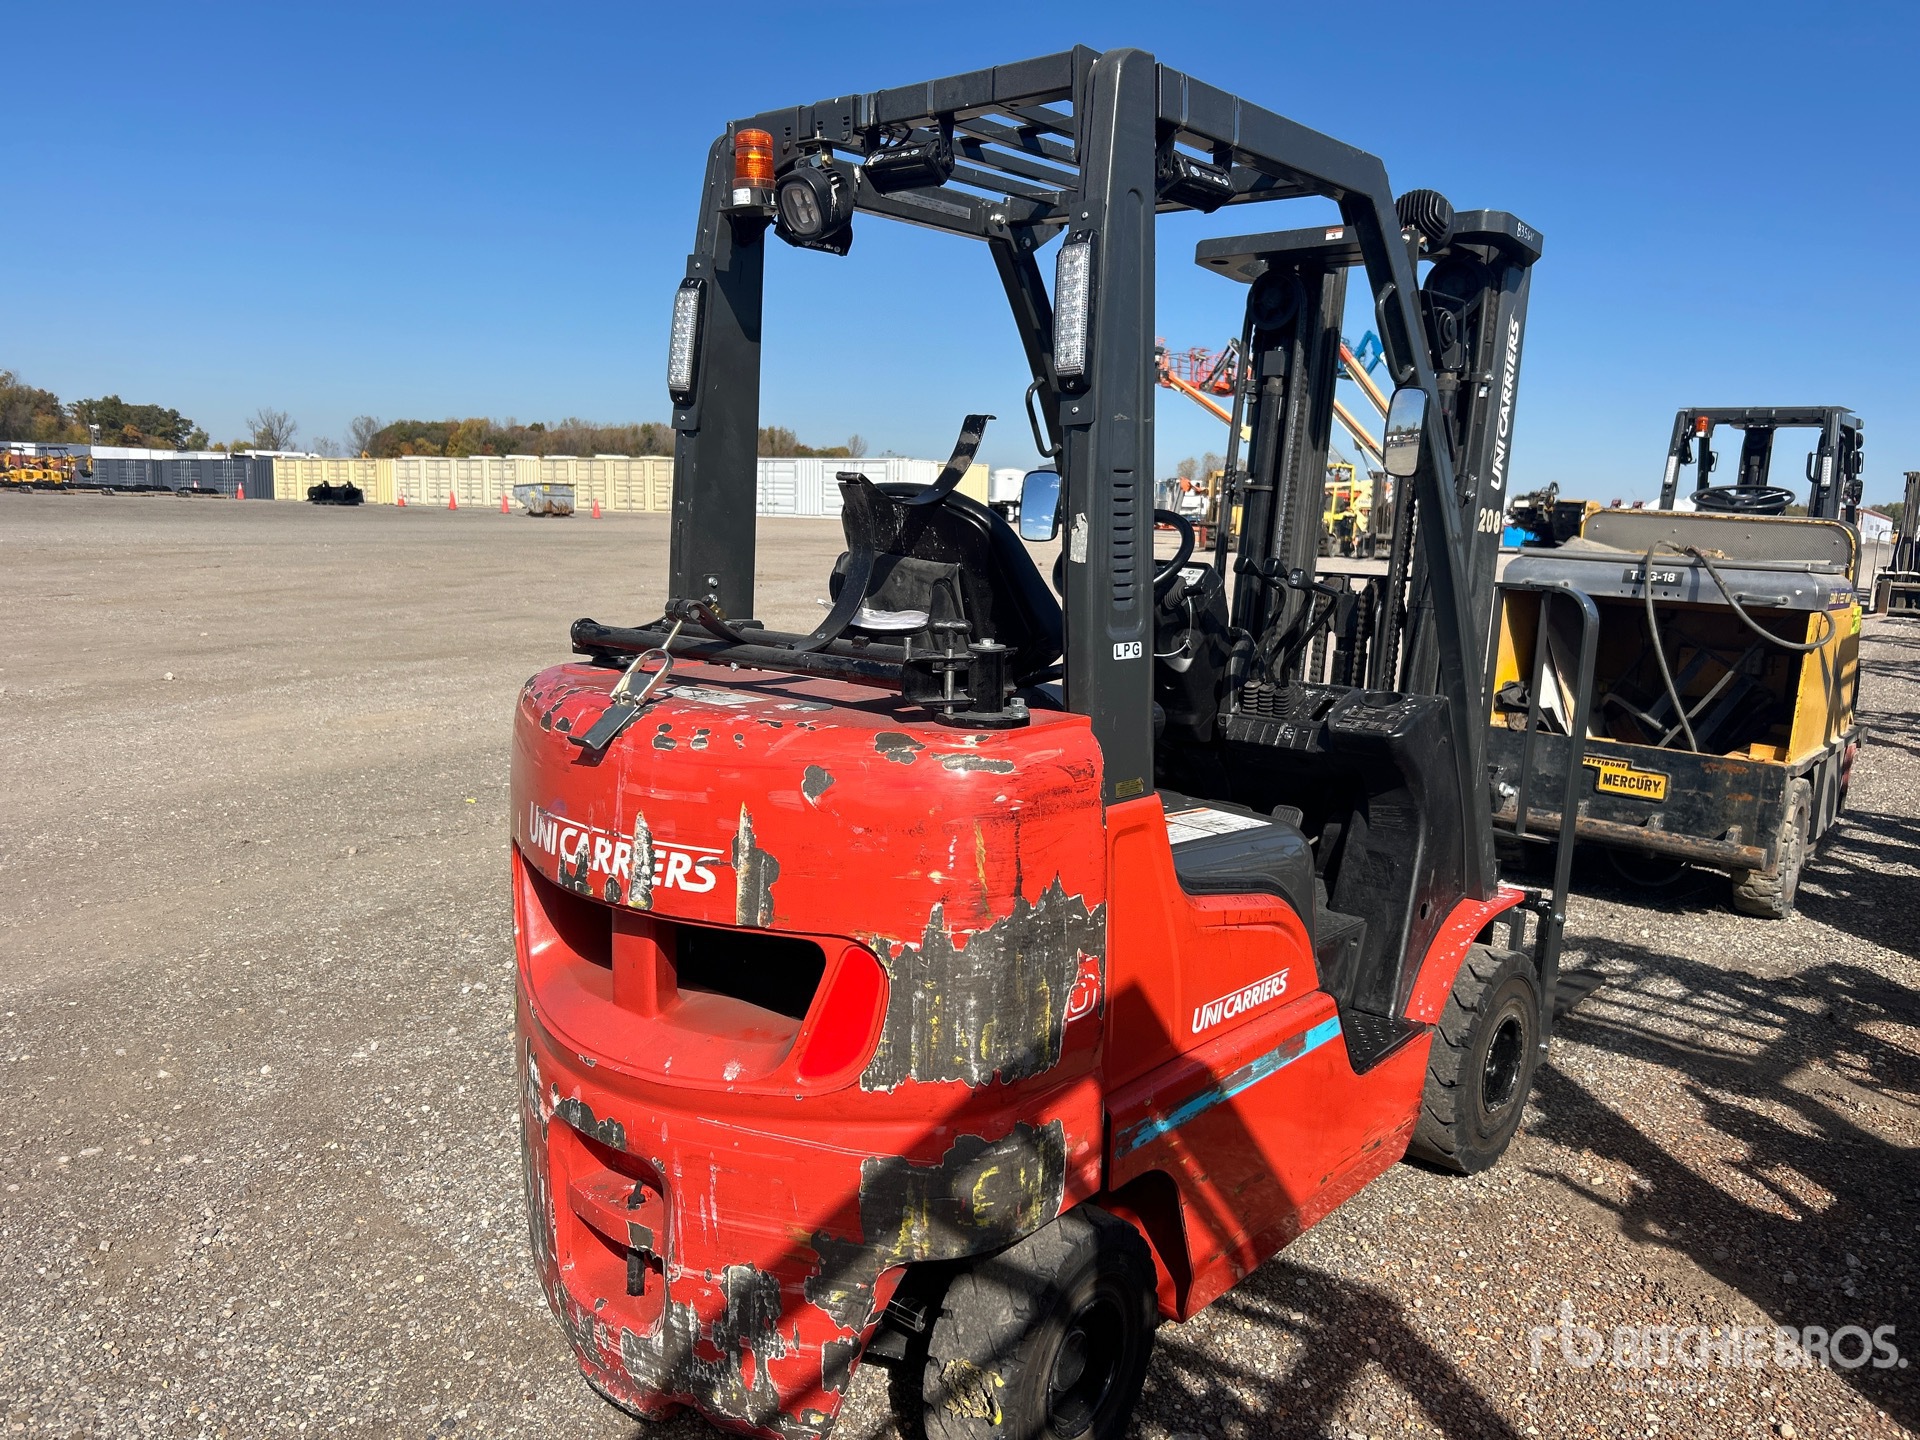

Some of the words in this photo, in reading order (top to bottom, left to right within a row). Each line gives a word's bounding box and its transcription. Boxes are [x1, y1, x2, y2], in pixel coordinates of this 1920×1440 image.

[1490, 318, 1520, 491] UNICARRIERS
[1115, 642, 1140, 658] LPG
[1602, 772, 1662, 793] MERCURY
[529, 801, 717, 894] UNICARRERS
[1191, 971, 1289, 1034] UNICARRIERS
